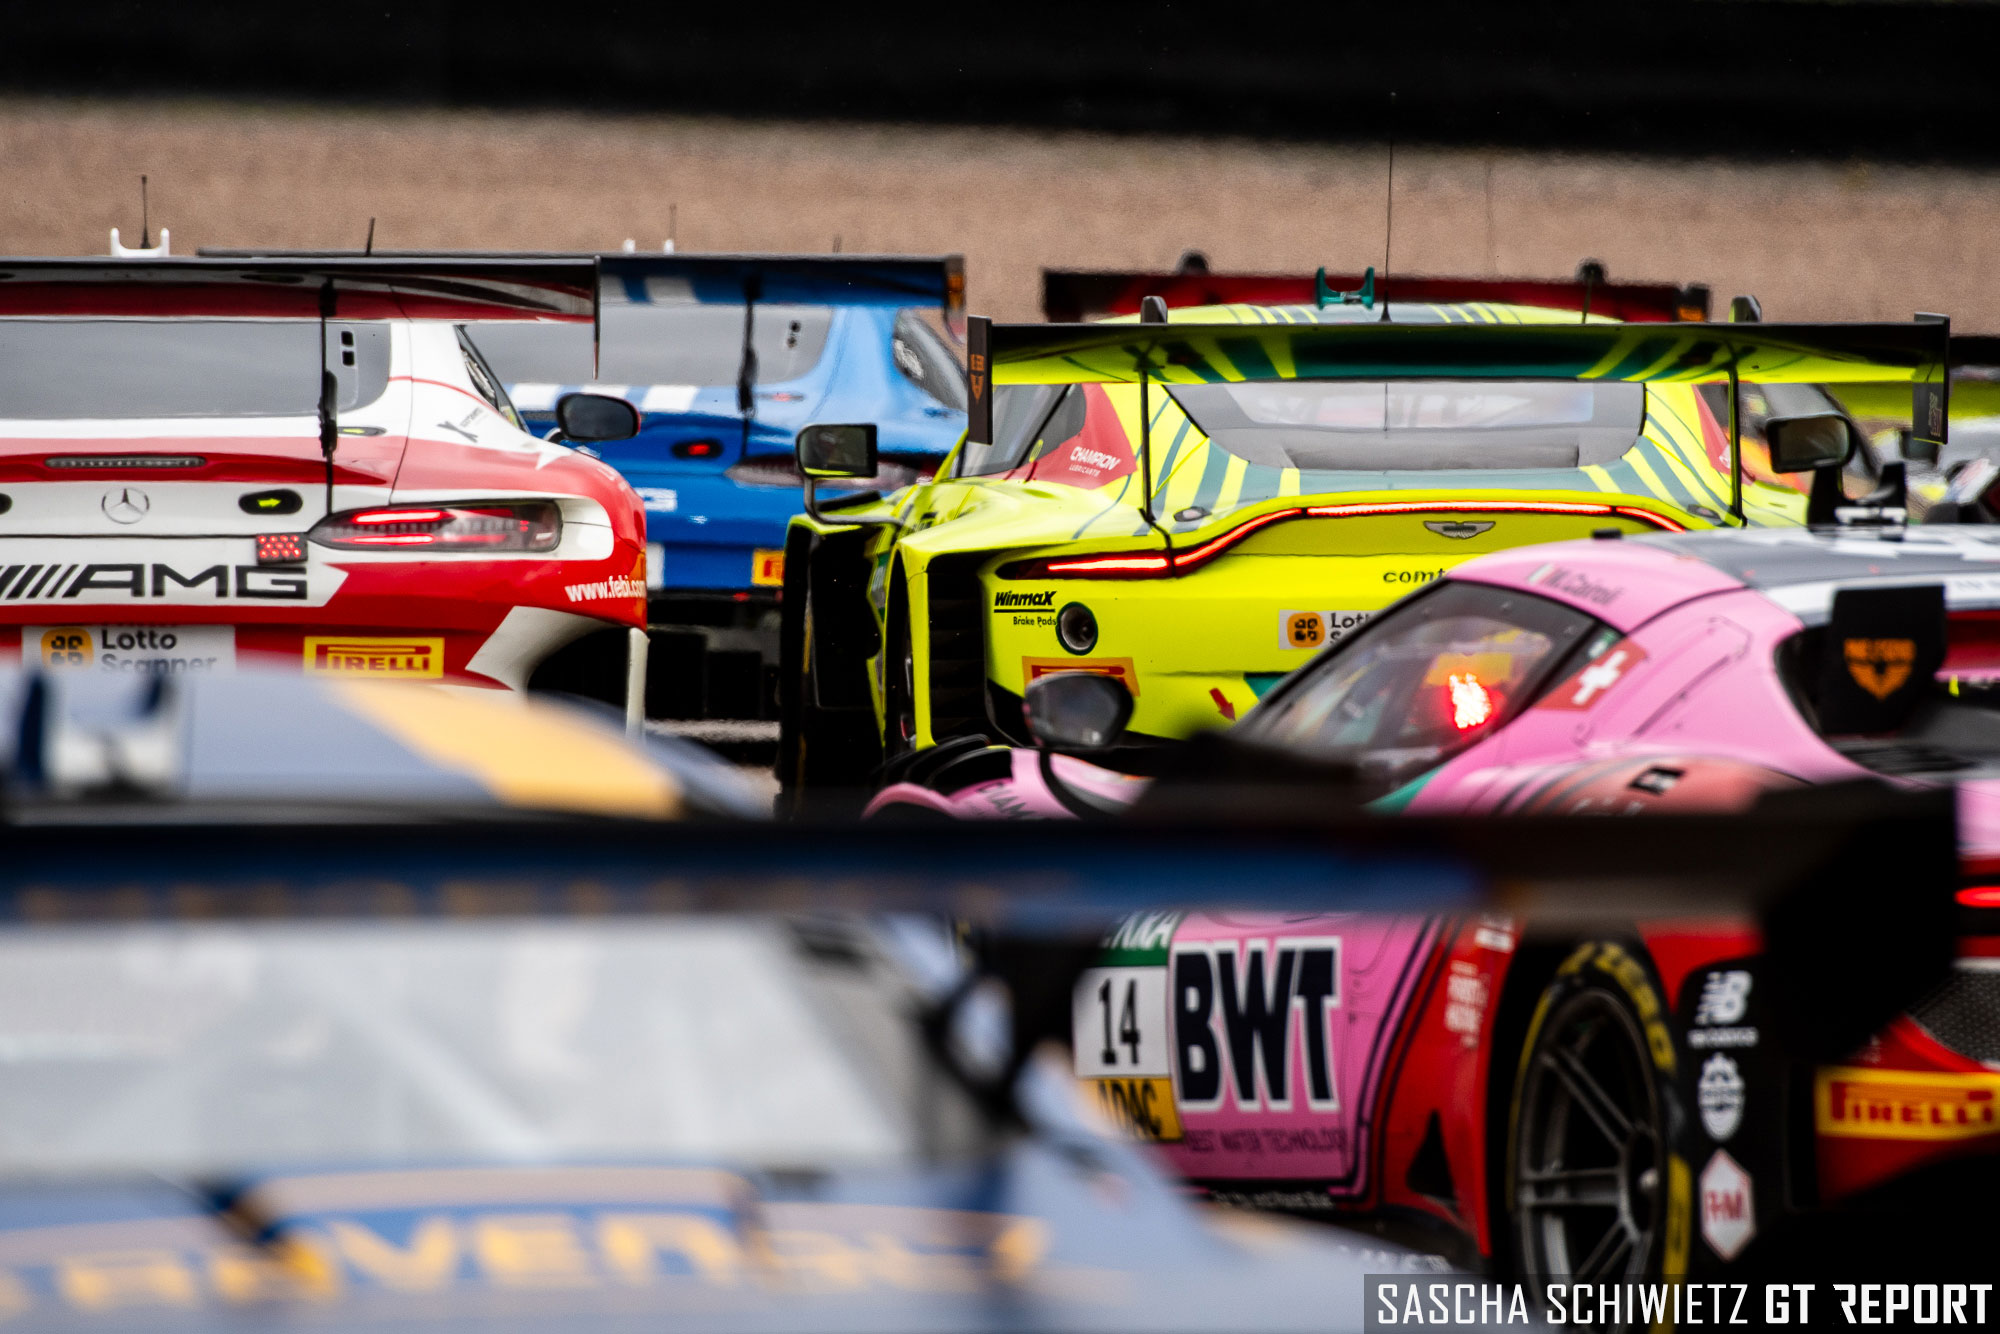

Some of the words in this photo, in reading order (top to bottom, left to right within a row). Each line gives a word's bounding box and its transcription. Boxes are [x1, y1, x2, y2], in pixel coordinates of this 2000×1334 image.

[1070, 446, 1121, 471] CHAMPION
[61, 563, 308, 600] AMG
[1013, 616, 1035, 626] Brake
[1037, 616, 1057, 628] Pads
[1331, 612, 1371, 629] Lot
[101, 629, 178, 651] Lotto
[101, 653, 218, 676] Scanner
[315, 644, 432, 671] PIRELLI
[1099, 978, 1140, 1066] 14
[1173, 938, 1342, 1112] BWT
[1830, 1082, 1995, 1125] PIRELLI
